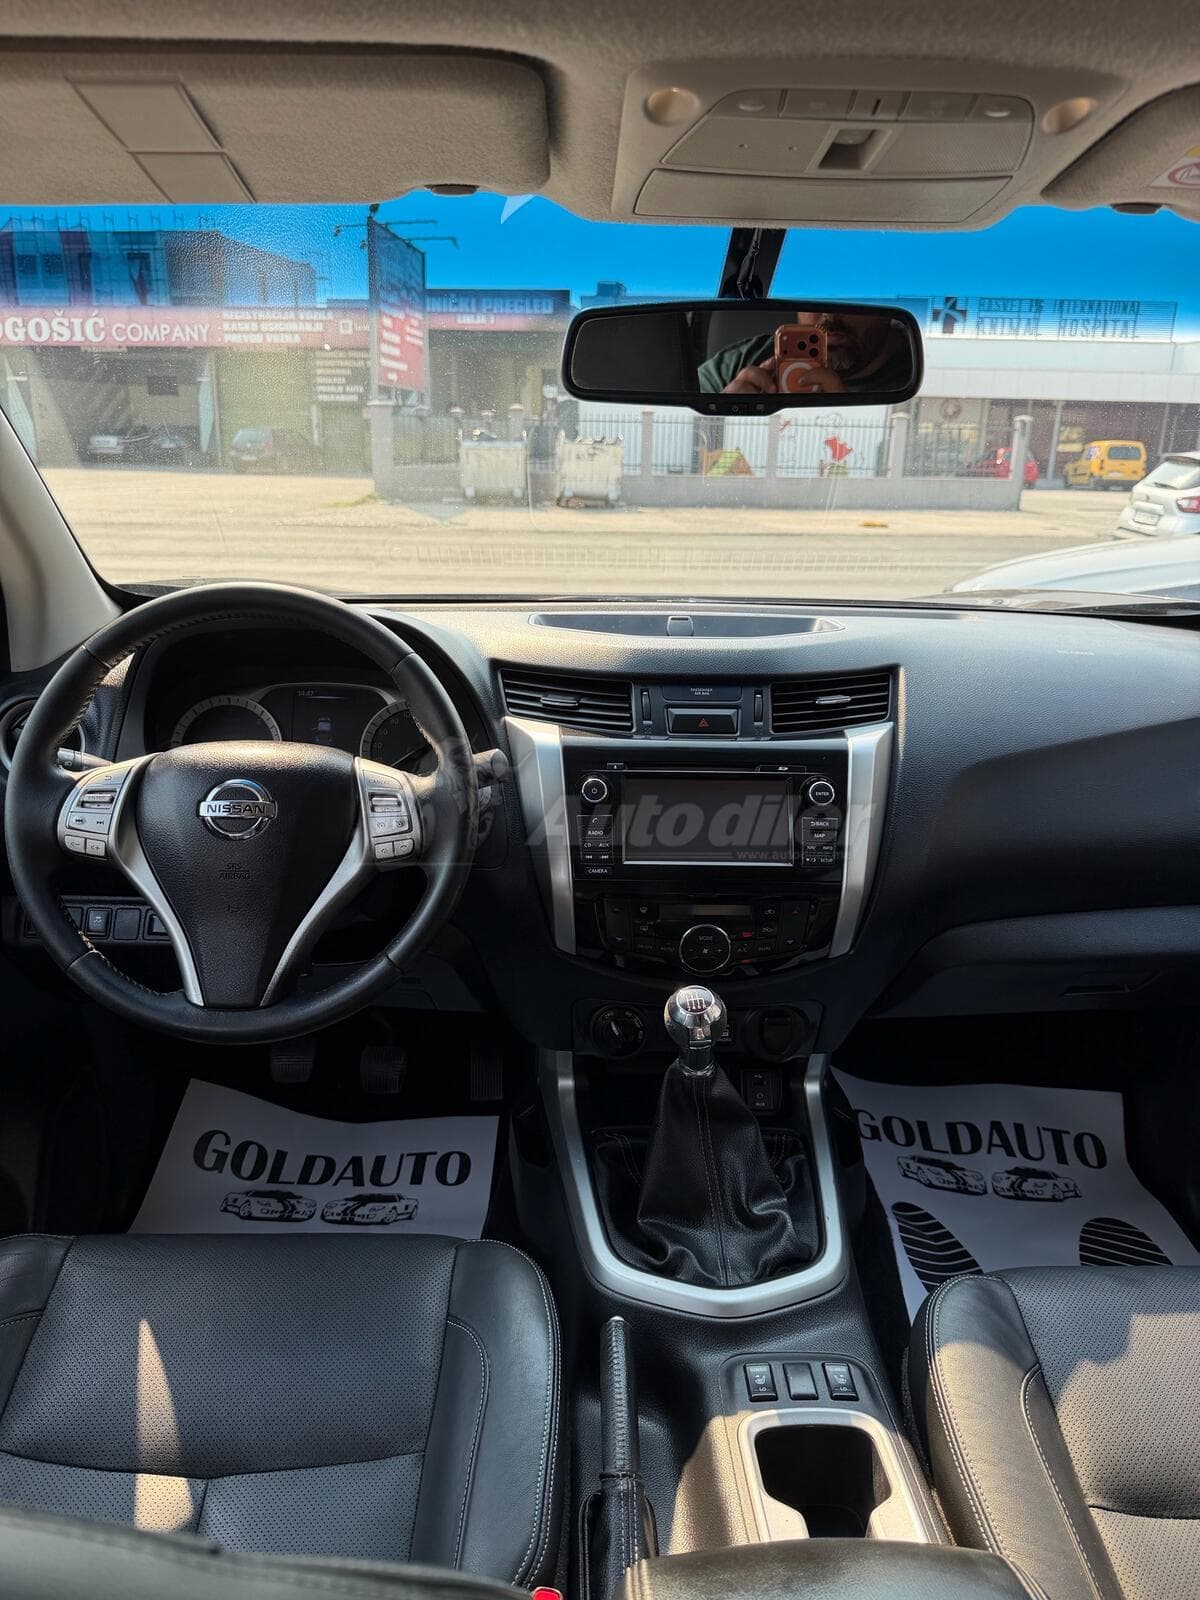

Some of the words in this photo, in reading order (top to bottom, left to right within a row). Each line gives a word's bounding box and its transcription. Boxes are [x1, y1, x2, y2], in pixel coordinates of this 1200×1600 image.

[0, 309, 106, 343] GOŠIĆ
[111, 322, 210, 344] COMPANY
[976, 316, 1042, 337] ANIMAL
[1058, 318, 1140, 339] HOSPITAL
[206, 804, 266, 814] NISSAN
[853, 1109, 1108, 1169] GOLDAUTO
[192, 1129, 472, 1187] GOLDAUTO
